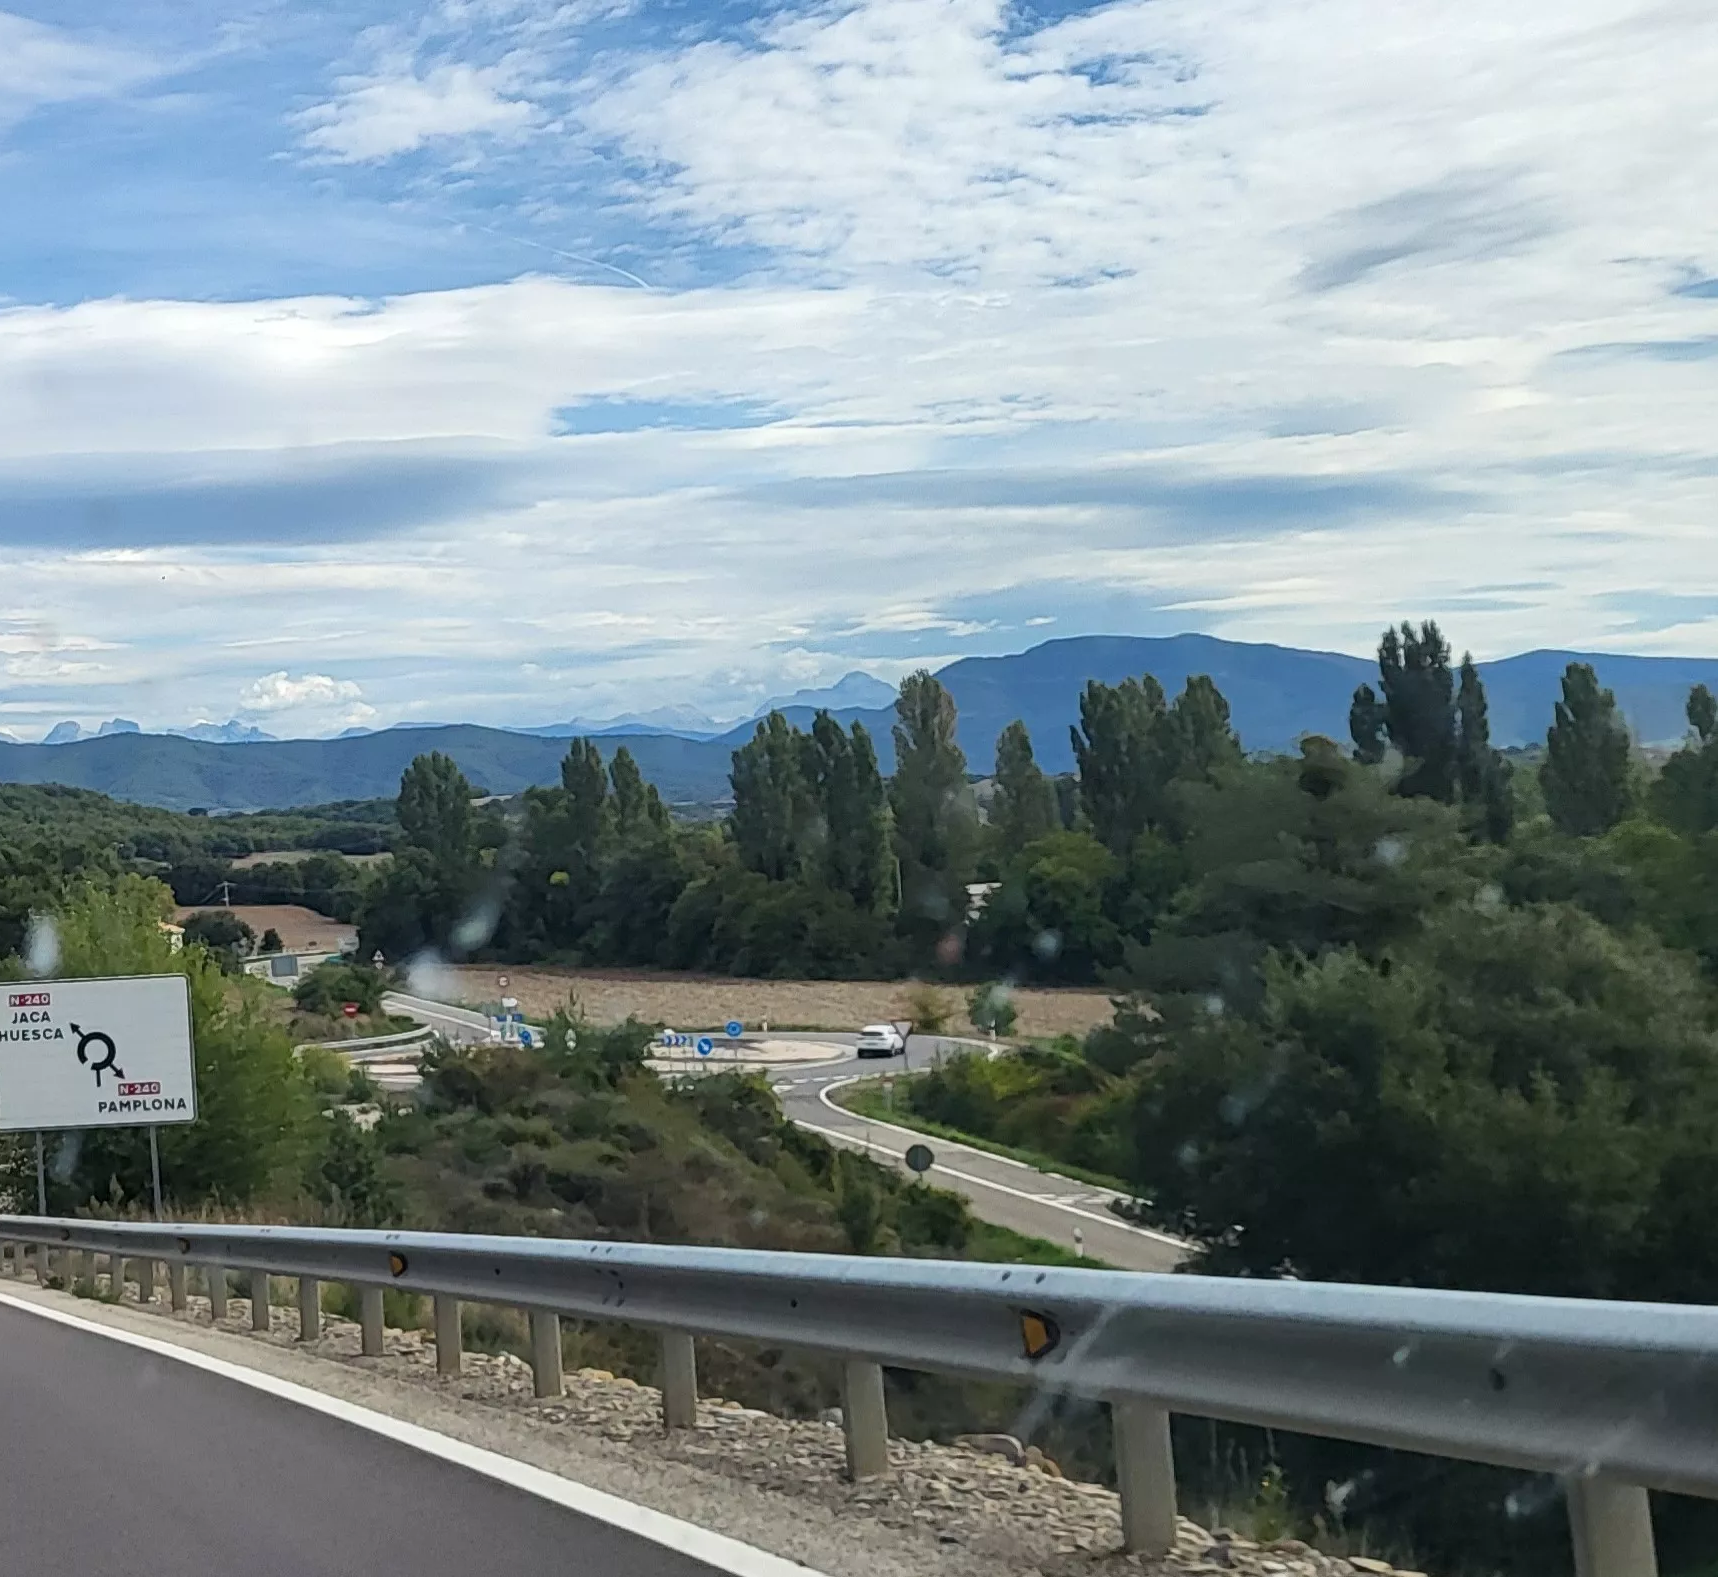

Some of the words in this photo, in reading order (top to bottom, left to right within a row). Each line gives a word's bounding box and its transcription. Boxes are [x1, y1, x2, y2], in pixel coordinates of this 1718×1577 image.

[11, 994, 49, 1006] N-240
[12, 1011, 51, 1024] JACA
[120, 1083, 159, 1095] N-240
[98, 1097, 187, 1113] PAMPLONA
